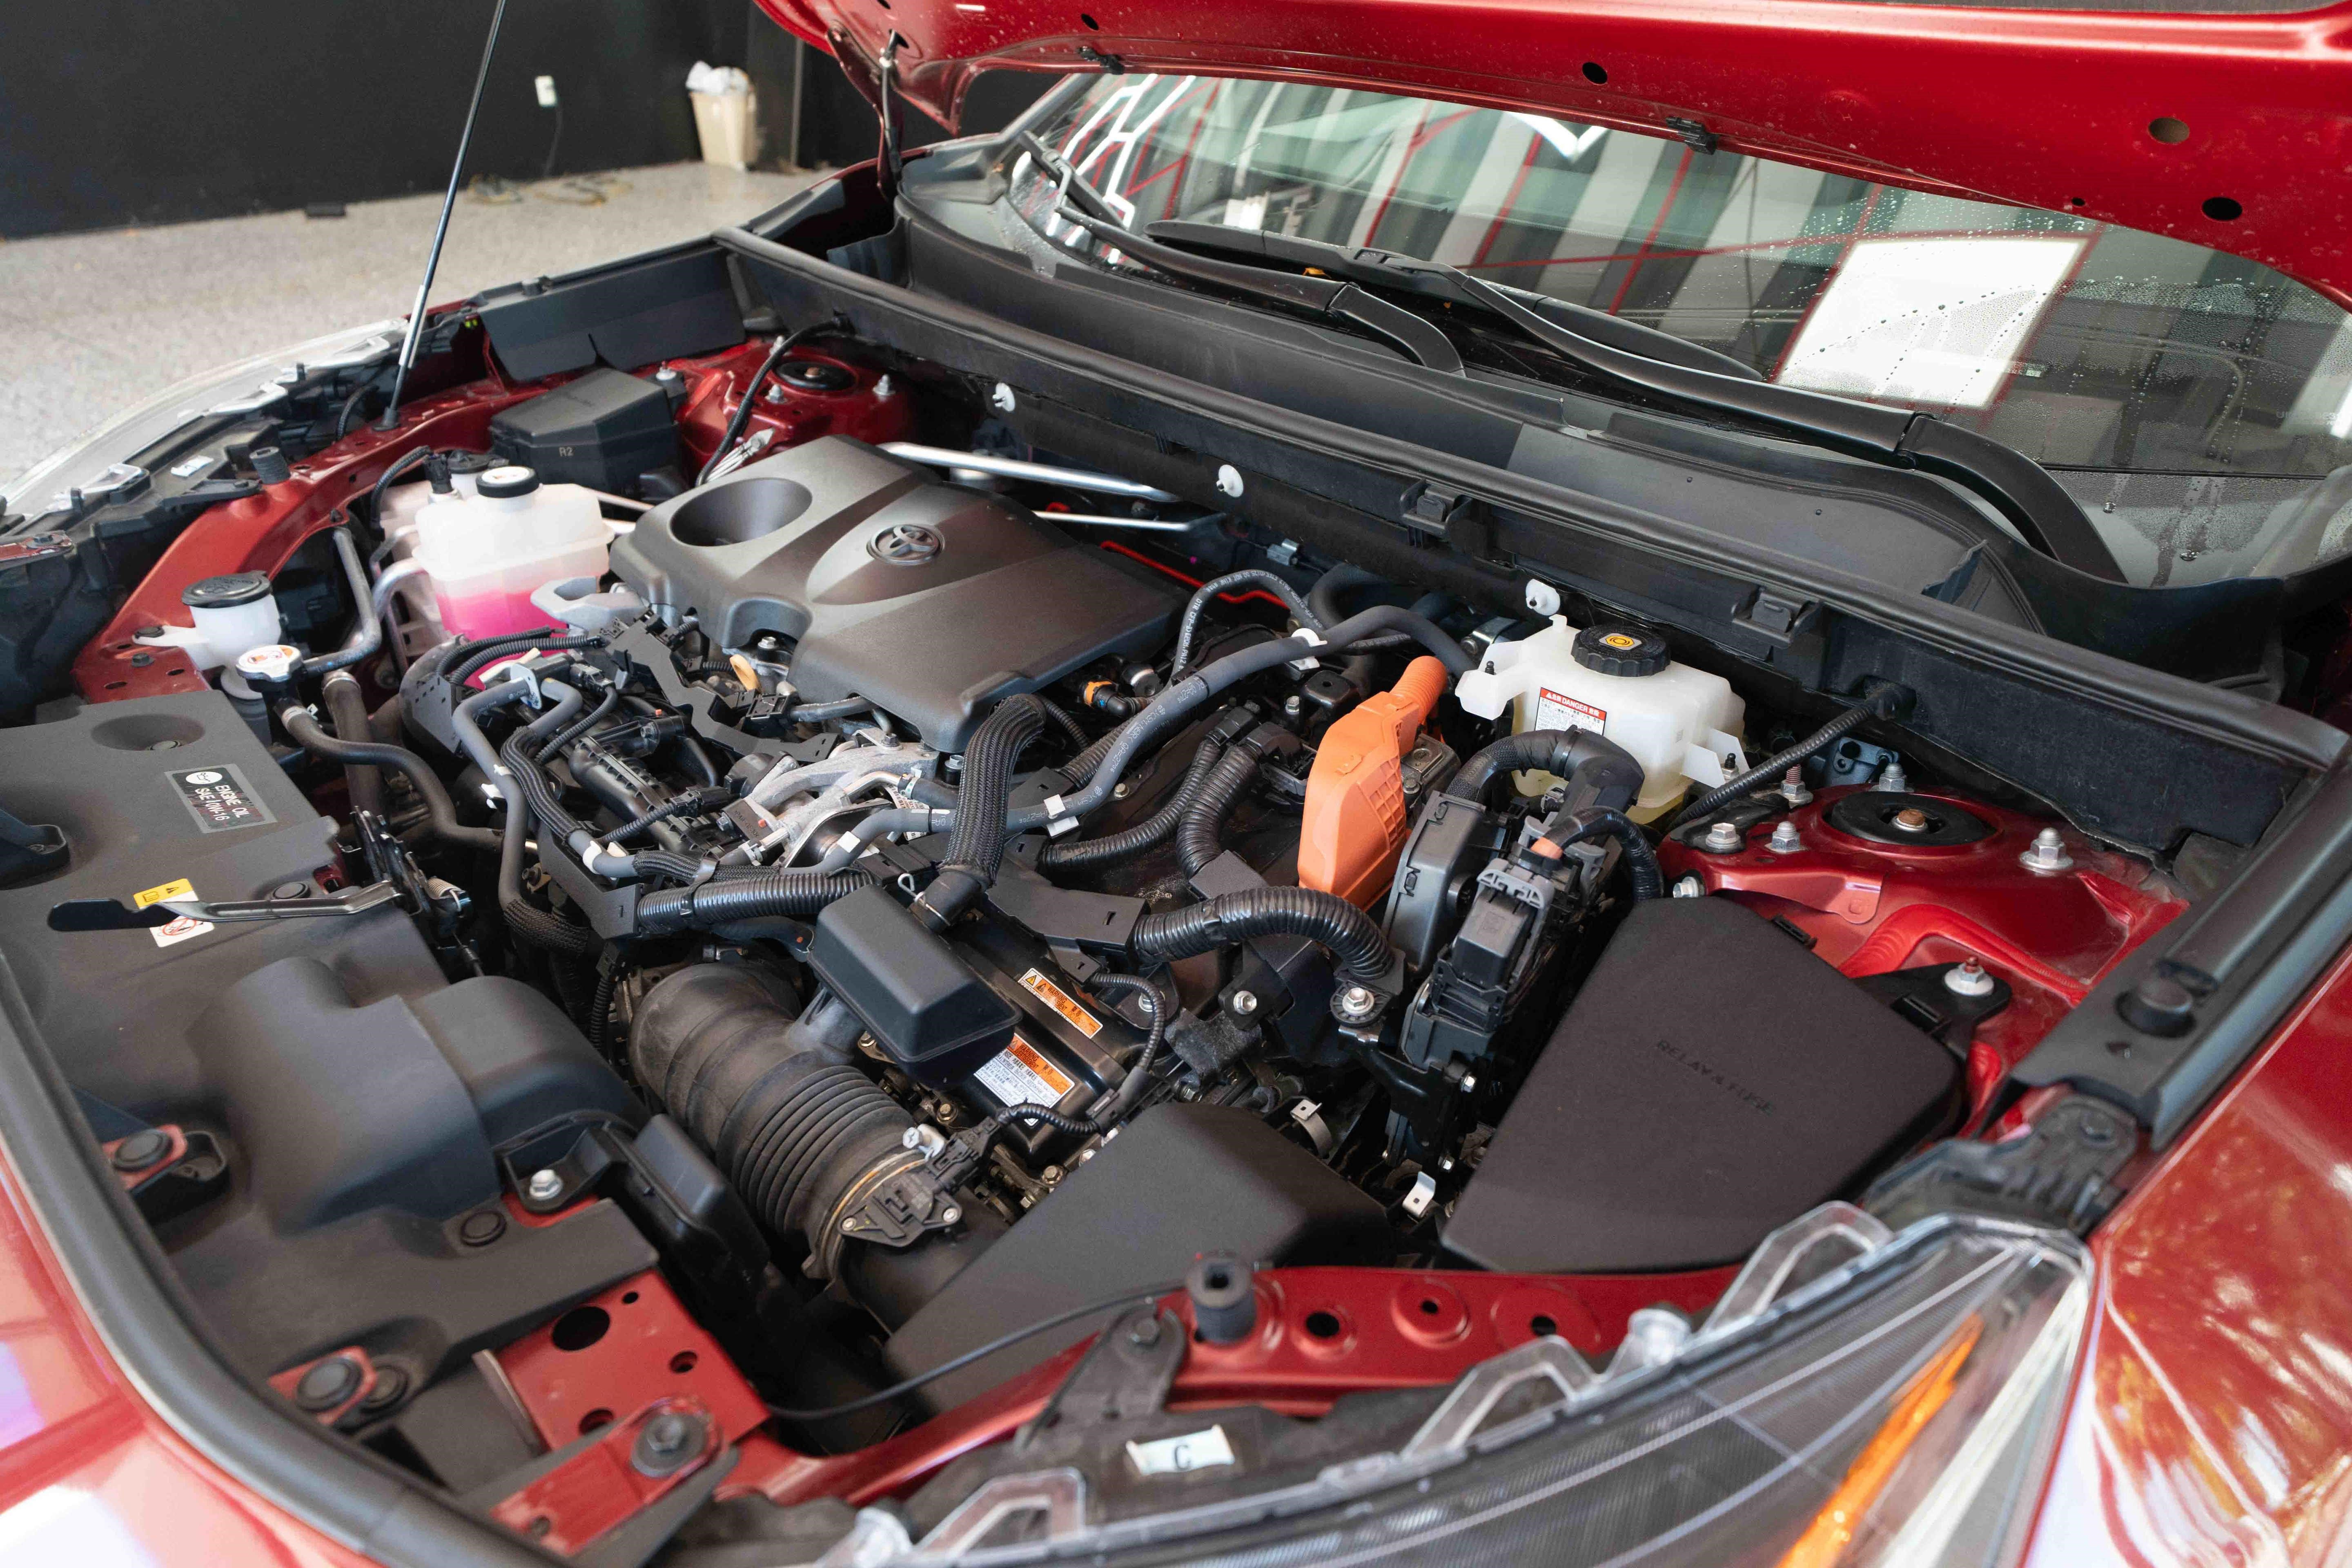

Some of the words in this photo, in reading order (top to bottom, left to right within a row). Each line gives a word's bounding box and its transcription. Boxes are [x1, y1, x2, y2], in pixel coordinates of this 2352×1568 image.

[559, 447, 573, 457] R2
[1562, 696, 1588, 712] DANGER
[195, 788, 215, 800] SAE
[205, 803, 230, 820] 0W-16
[215, 785, 242, 806] ENGINE
[232, 807, 249, 818] OIL
[1048, 986, 1067, 1004] WARNING
[1019, 1044, 1039, 1061] WARNING
[1175, 1444, 1191, 1470] C
